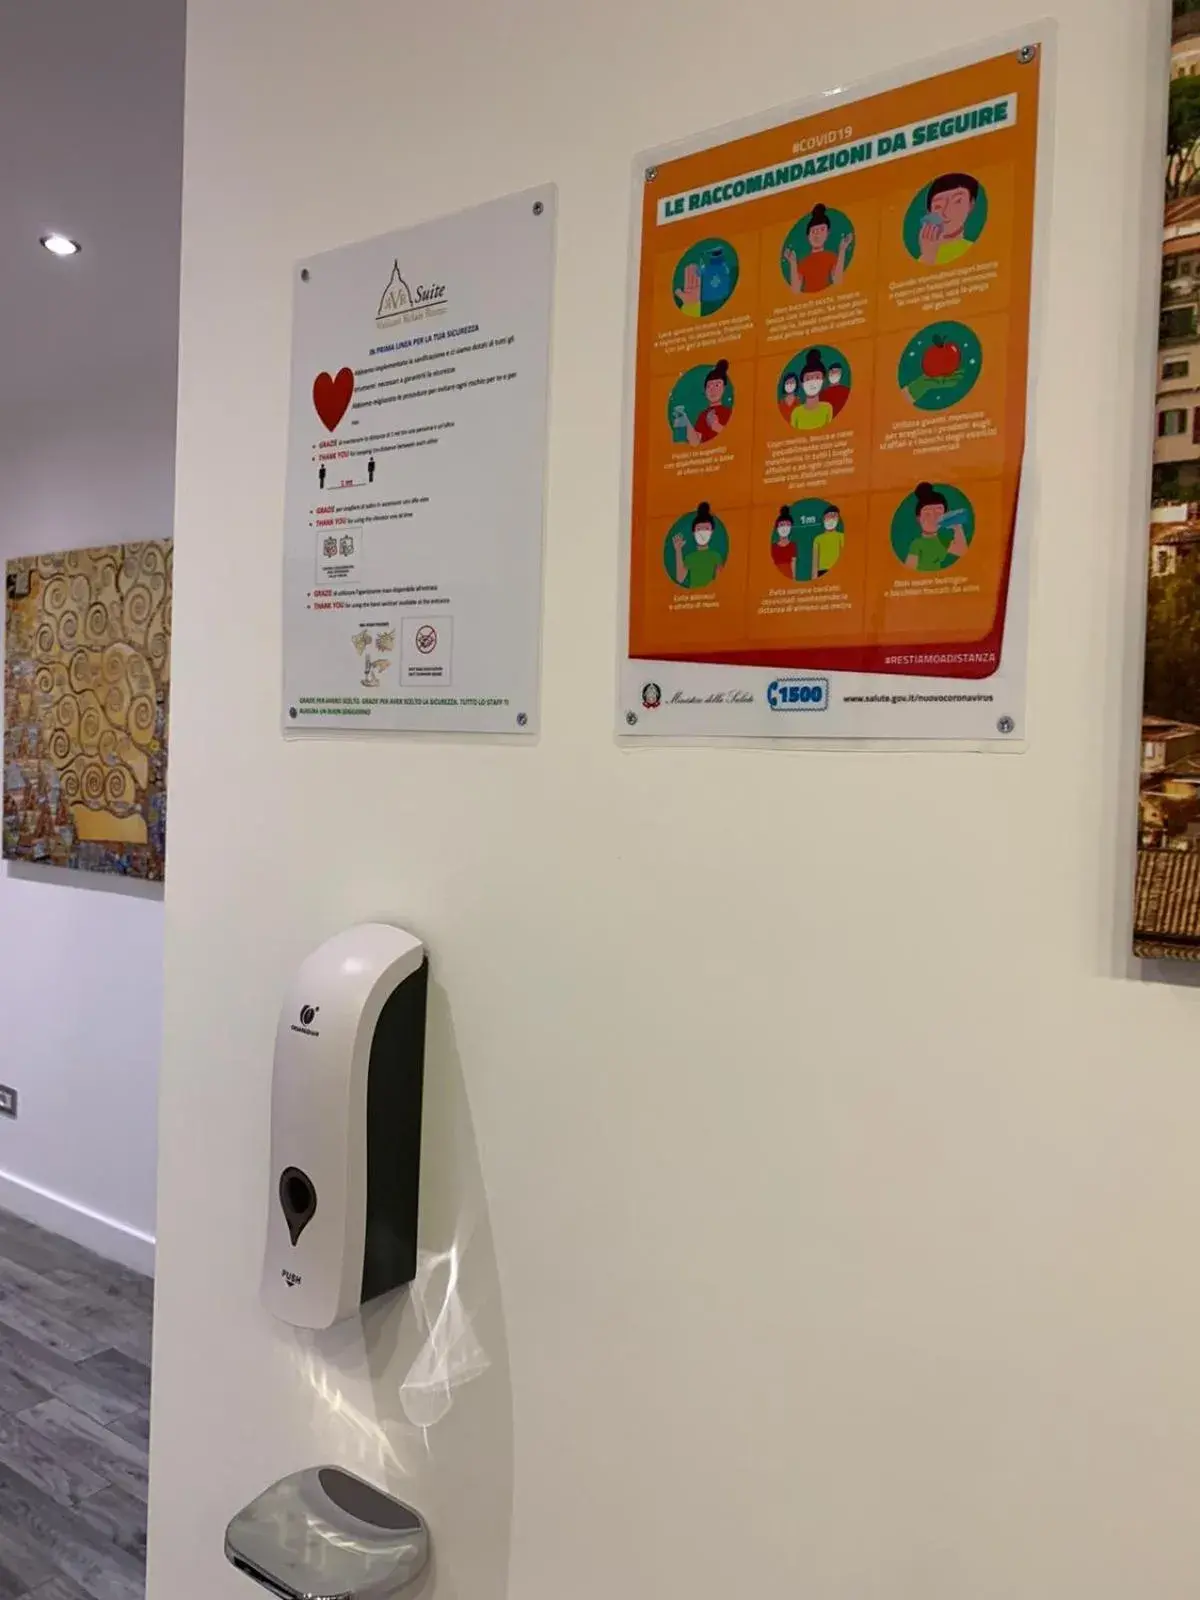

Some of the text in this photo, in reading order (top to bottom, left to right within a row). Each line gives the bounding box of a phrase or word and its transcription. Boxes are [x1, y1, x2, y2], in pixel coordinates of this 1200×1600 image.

[792, 125, 852, 154] #COVID19
[665, 101, 1009, 218] LE RACCOMANDAZIONI DA SEGUIRE
[414, 283, 446, 303] Suite
[446, 323, 479, 337] SICUREZZA
[318, 439, 337, 448] GRAZIE
[318, 452, 336, 461] THANK
[337, 450, 349, 458] YOU
[315, 505, 334, 514] GRAZIE
[315, 519, 333, 527] THANK
[334, 517, 346, 525] YOU
[800, 515, 817, 525] 1m
[884, 652, 996, 665] #RESTIAMOADISTANZA
[777, 686, 823, 703] 1500
[842, 693, 994, 704] www.salute.gov.it/nuovocoronavirus
[281, 1269, 302, 1284] PUSH
